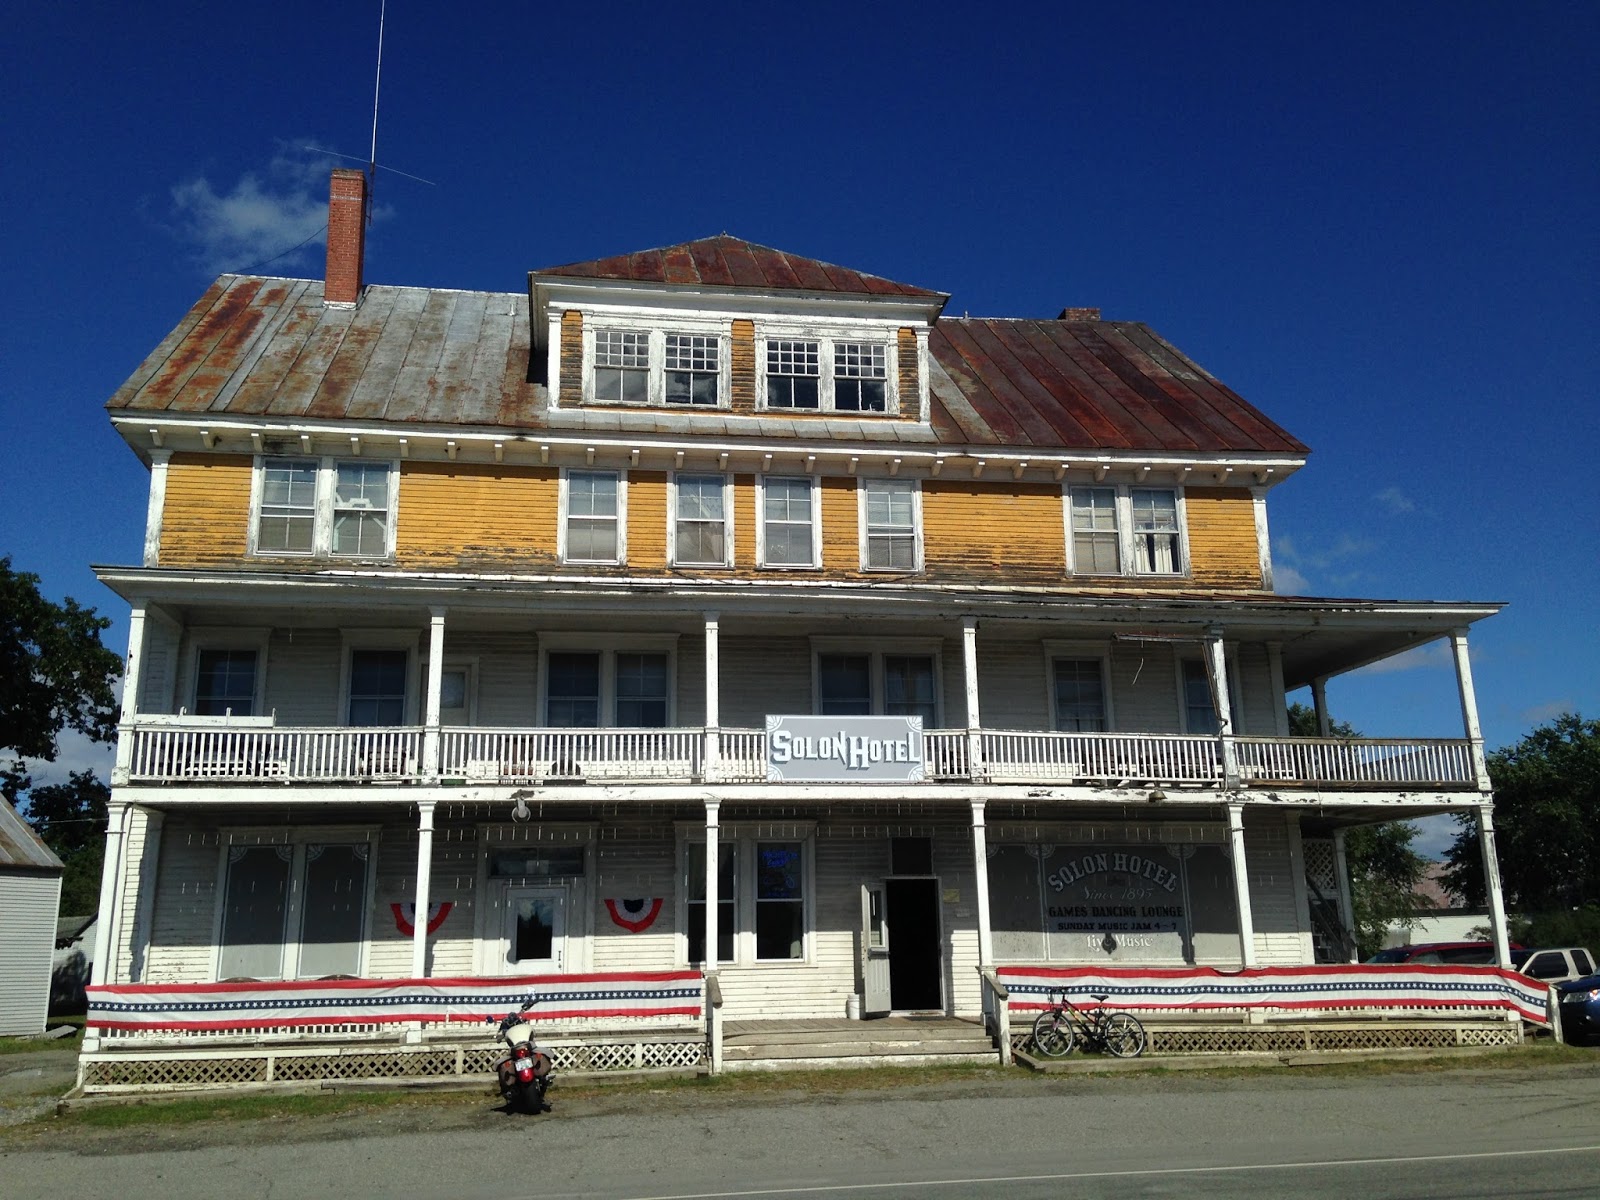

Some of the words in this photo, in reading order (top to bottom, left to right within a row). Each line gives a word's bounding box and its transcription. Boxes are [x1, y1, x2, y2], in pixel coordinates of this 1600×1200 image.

[770, 730, 847, 765] SOLON
[846, 731, 921, 770] HOTEL
[1048, 852, 1108, 892] SOLON
[1113, 852, 1178, 893] HOTEL
[1083, 885, 1114, 900] Since
[1121, 887, 1155, 900] 1895
[1049, 906, 1088, 918] GAMES
[1092, 905, 1137, 918] DANCING
[1142, 905, 1183, 918] LOUNGE
[1057, 922, 1095, 930] SUNDAY
[1098, 922, 1128, 930] MUSIC
[1130, 922, 1152, 930] JAM
[1115, 934, 1153, 947] Music
